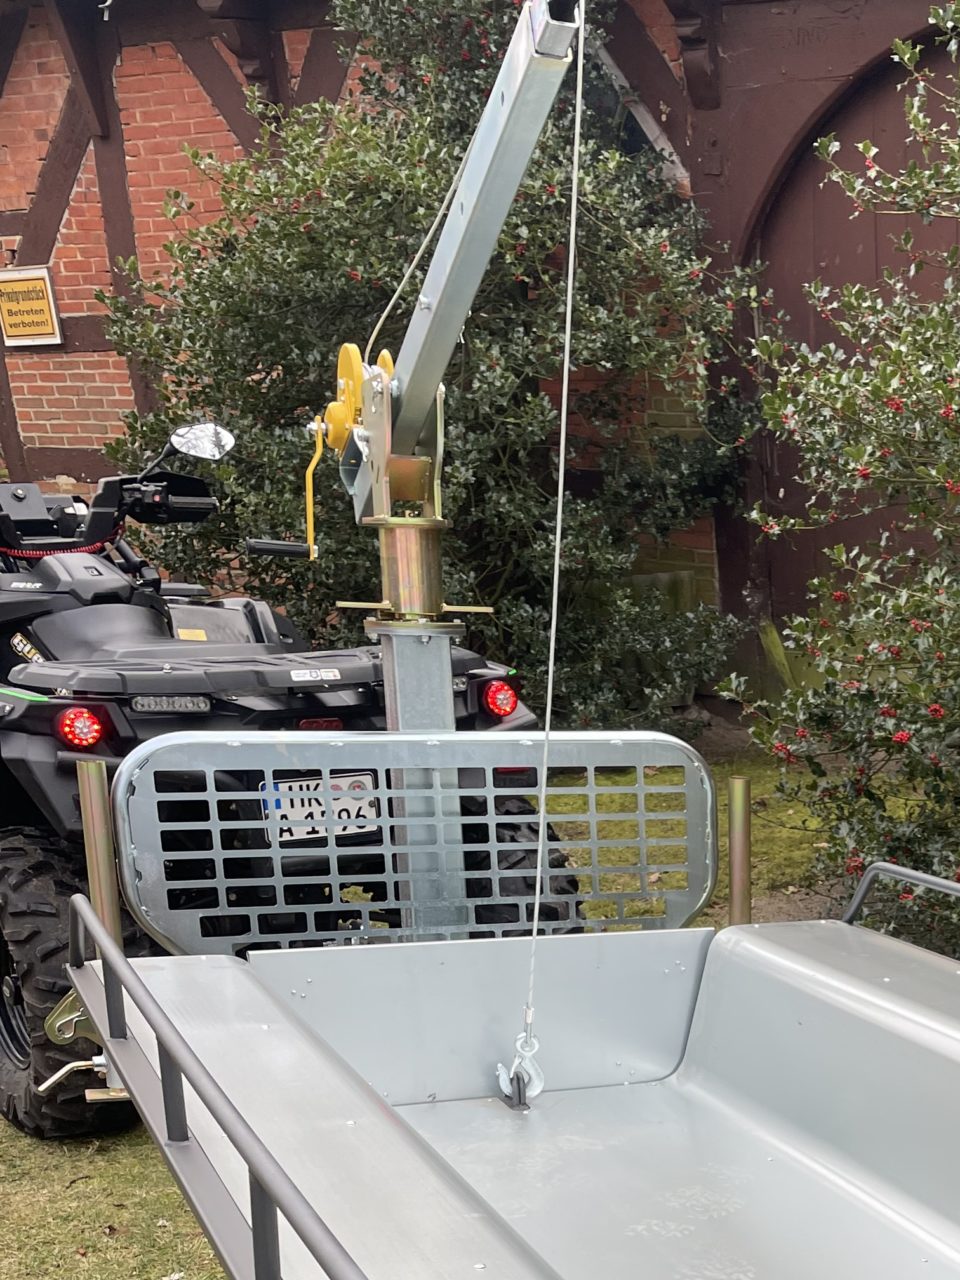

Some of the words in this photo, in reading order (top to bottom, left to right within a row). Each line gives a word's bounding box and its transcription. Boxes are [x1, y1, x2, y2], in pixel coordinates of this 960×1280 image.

[7, 308, 45, 317] Betreten
[8, 319, 49, 328] verboten!
[279, 813, 294, 838] A
